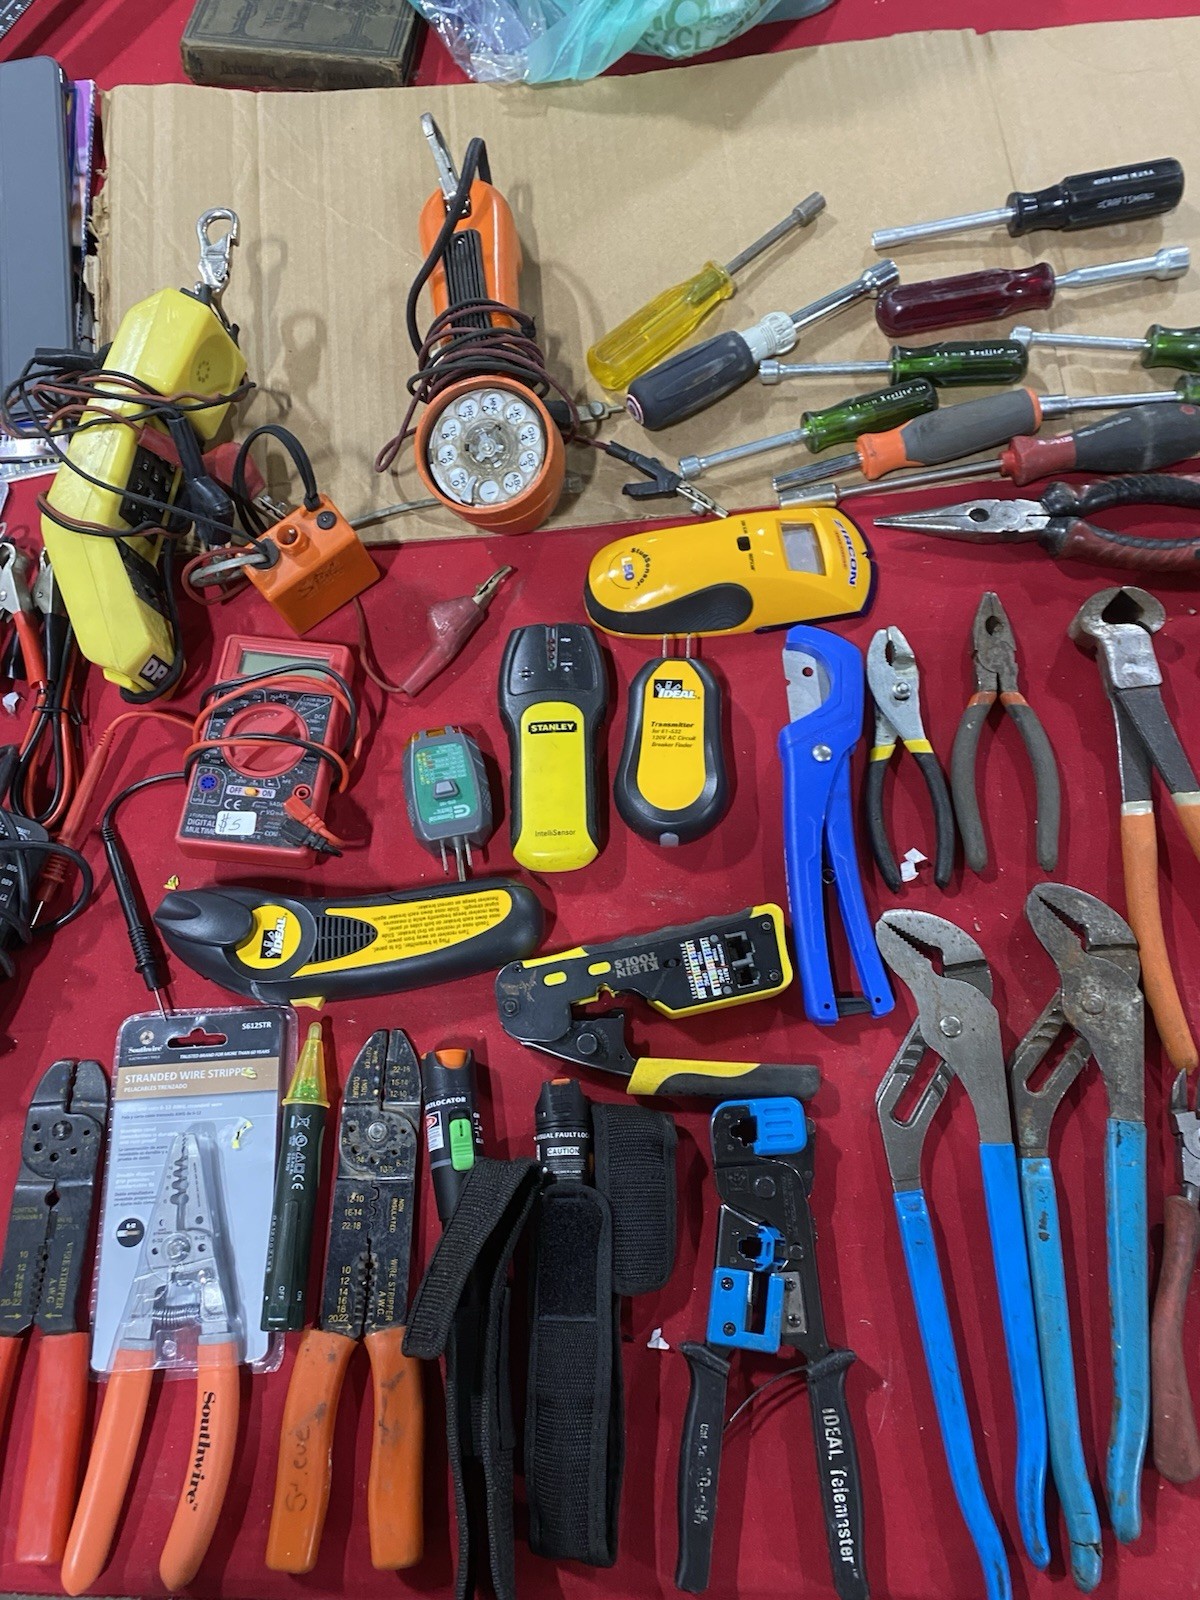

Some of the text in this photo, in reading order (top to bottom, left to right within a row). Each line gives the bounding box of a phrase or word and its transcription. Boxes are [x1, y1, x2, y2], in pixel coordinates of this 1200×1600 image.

[481, 404, 489, 412] 6
[440, 431, 450, 440] 8
[519, 433, 528, 441] 4
[526, 426, 537, 443] GHI
[439, 456, 448, 465] 9
[518, 459, 528, 468] 3
[526, 452, 535, 468] DEF
[451, 479, 461, 487] 0
[504, 480, 514, 489] 2
[511, 472, 522, 491] ABC
[833, 519, 857, 587] ZIRCON
[631, 548, 652, 587] StudSensor
[141, 658, 169, 681] DP
[658, 688, 696, 699] IDEAL
[530, 723, 574, 733] STANLEY
[229, 786, 242, 794] OFF
[224, 798, 243, 810] CE
[186, 818, 216, 827] DIGITAL
[185, 826, 216, 835] MULTIME
[535, 829, 576, 837] IntelliSensor
[271, 917, 286, 954] IDEAL
[614, 952, 658, 969] TOOLS
[616, 961, 660, 979] KLEIN
[242, 1022, 272, 1030] S612STR
[128, 1045, 162, 1054] Southwire
[125, 1067, 253, 1084] STRANDED WIRE STRIPPE
[124, 1085, 157, 1093] PELACABLES
[390, 1090, 408, 1098] 12-10
[389, 1197, 397, 1233] INSULATED
[342, 1222, 362, 1230] 22-18
[342, 1266, 351, 1274] 10
[340, 1277, 350, 1285] 12
[55, 1267, 69, 1309] STRIPPER
[339, 1288, 348, 1296] 14
[385, 1259, 399, 1322] WIRE STRIPPER
[338, 1297, 347, 1305] 16
[337, 1305, 346, 1313] 18
[186, 1391, 217, 1504] Southwire
[822, 1407, 855, 1564] IDEAL Telemaster
